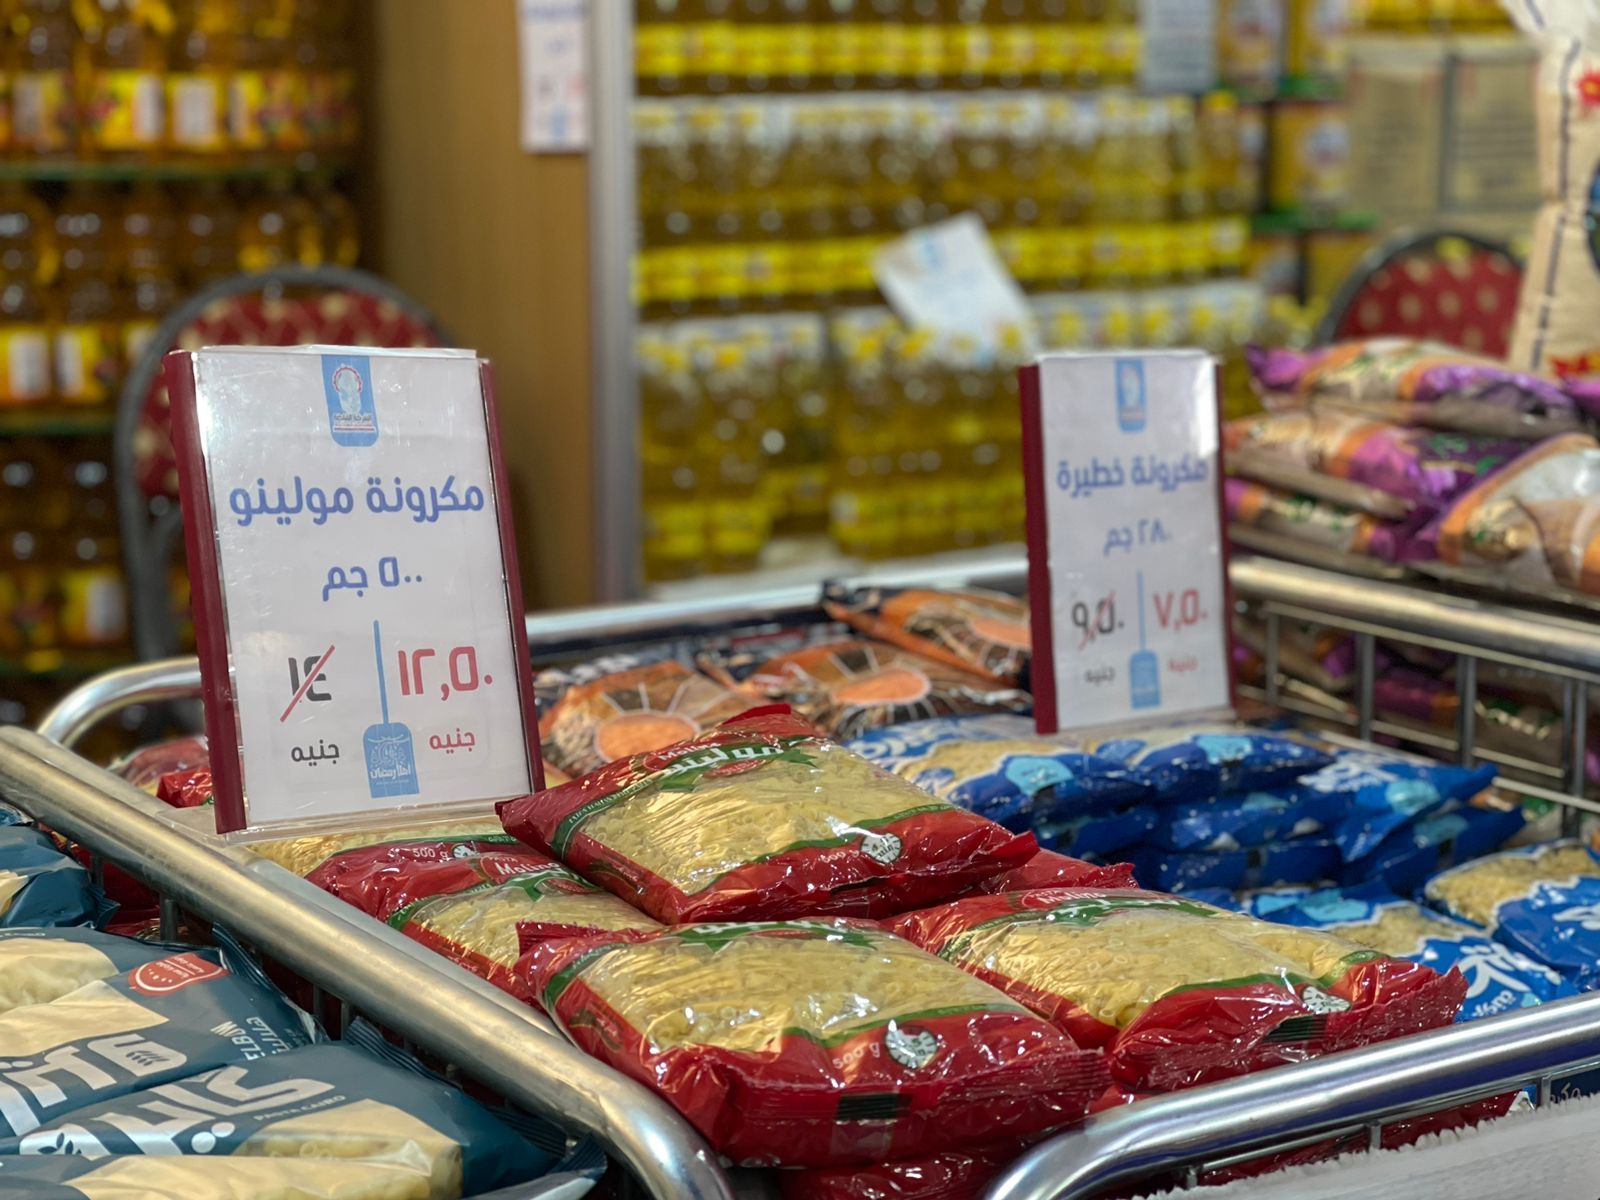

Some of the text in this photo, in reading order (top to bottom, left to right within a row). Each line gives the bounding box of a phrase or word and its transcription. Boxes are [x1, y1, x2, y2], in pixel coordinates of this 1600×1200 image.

[229, 475, 485, 526] مكرونة مولينو
[322, 566, 369, 602] جم
[291, 739, 340, 767] جنيه
[429, 728, 476, 754] جنيه
[412, 847, 436, 858] 500
[494, 862, 560, 875] Molino
[832, 1047, 865, 1070] 500
